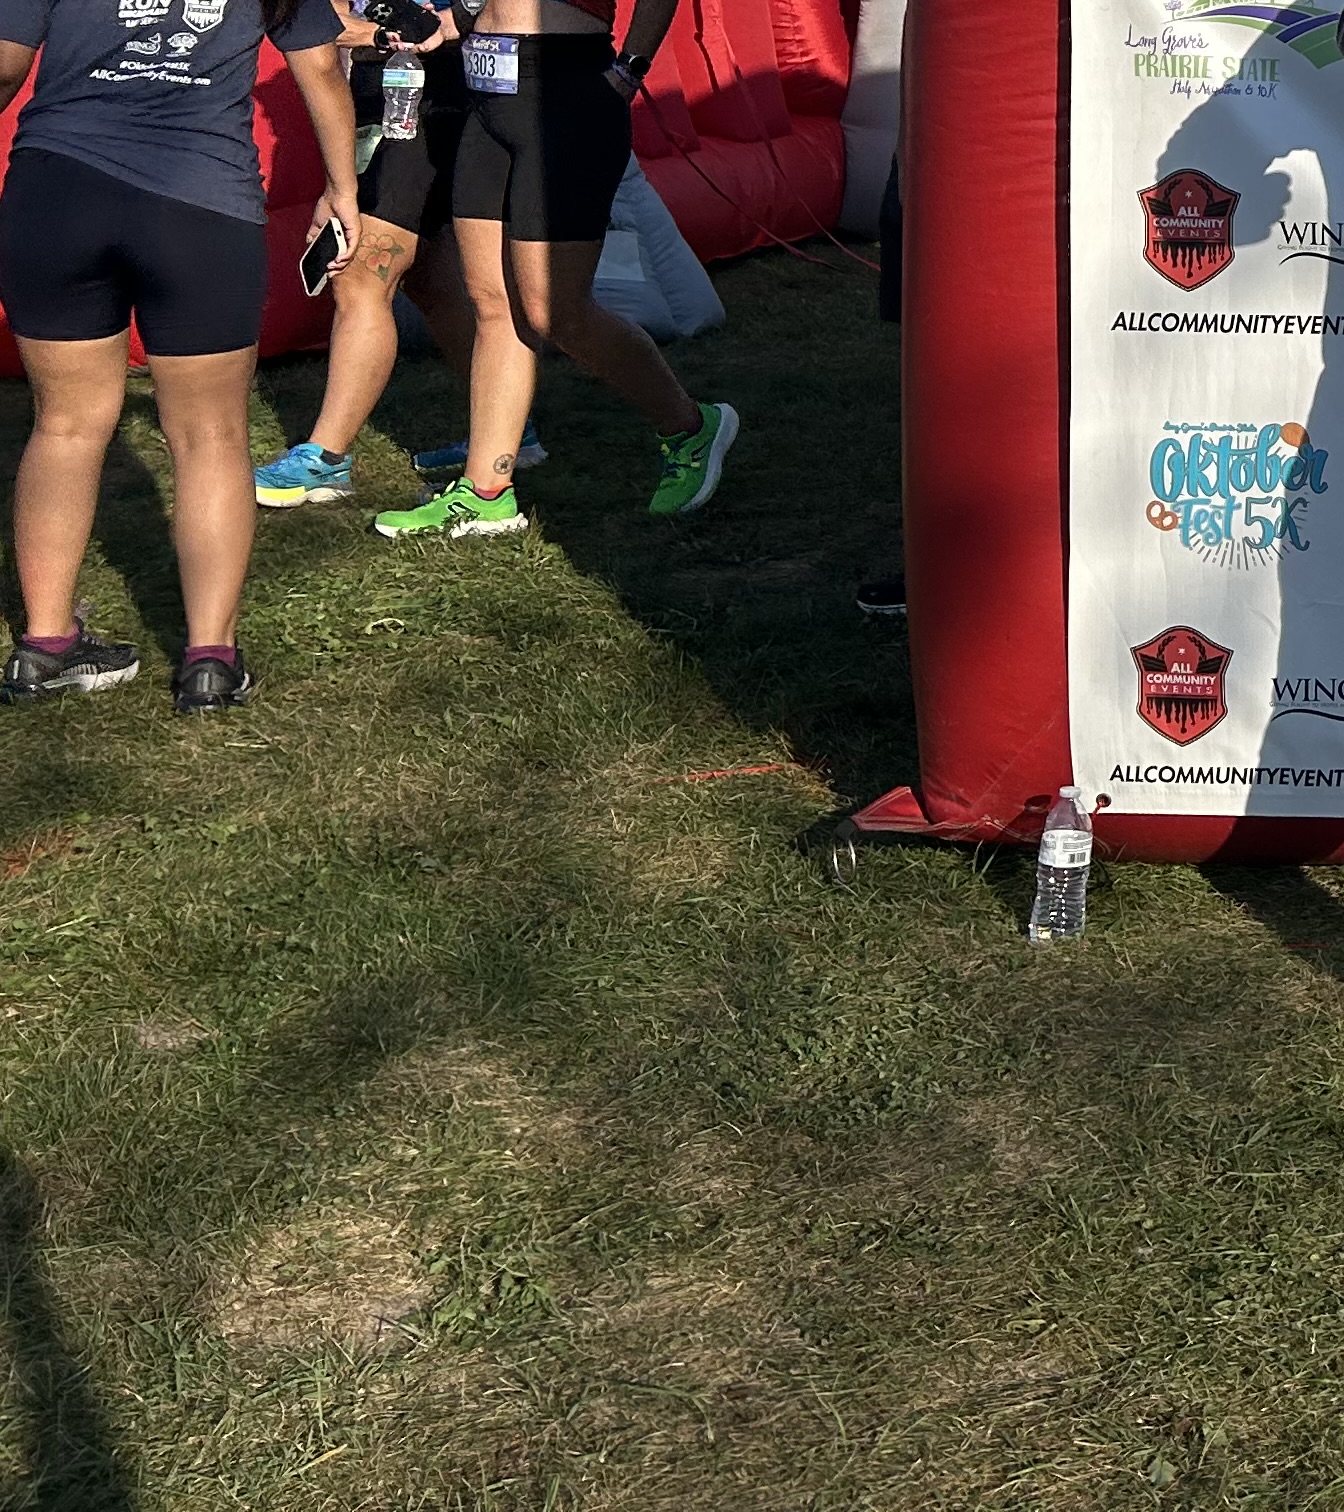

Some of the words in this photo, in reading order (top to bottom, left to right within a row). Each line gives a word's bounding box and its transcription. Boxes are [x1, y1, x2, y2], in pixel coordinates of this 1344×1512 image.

[1134, 53, 1214, 78] PRAIRIE
[1222, 56, 1281, 82] STATE
[1150, 422, 1328, 505] Oktober
[1171, 494, 1242, 548] Fest
[1244, 495, 1310, 551] 5K
[1170, 662, 1193, 673] ALL
[1146, 673, 1217, 684] COMMUNITY
[1150, 683, 1213, 693] EVENTS
